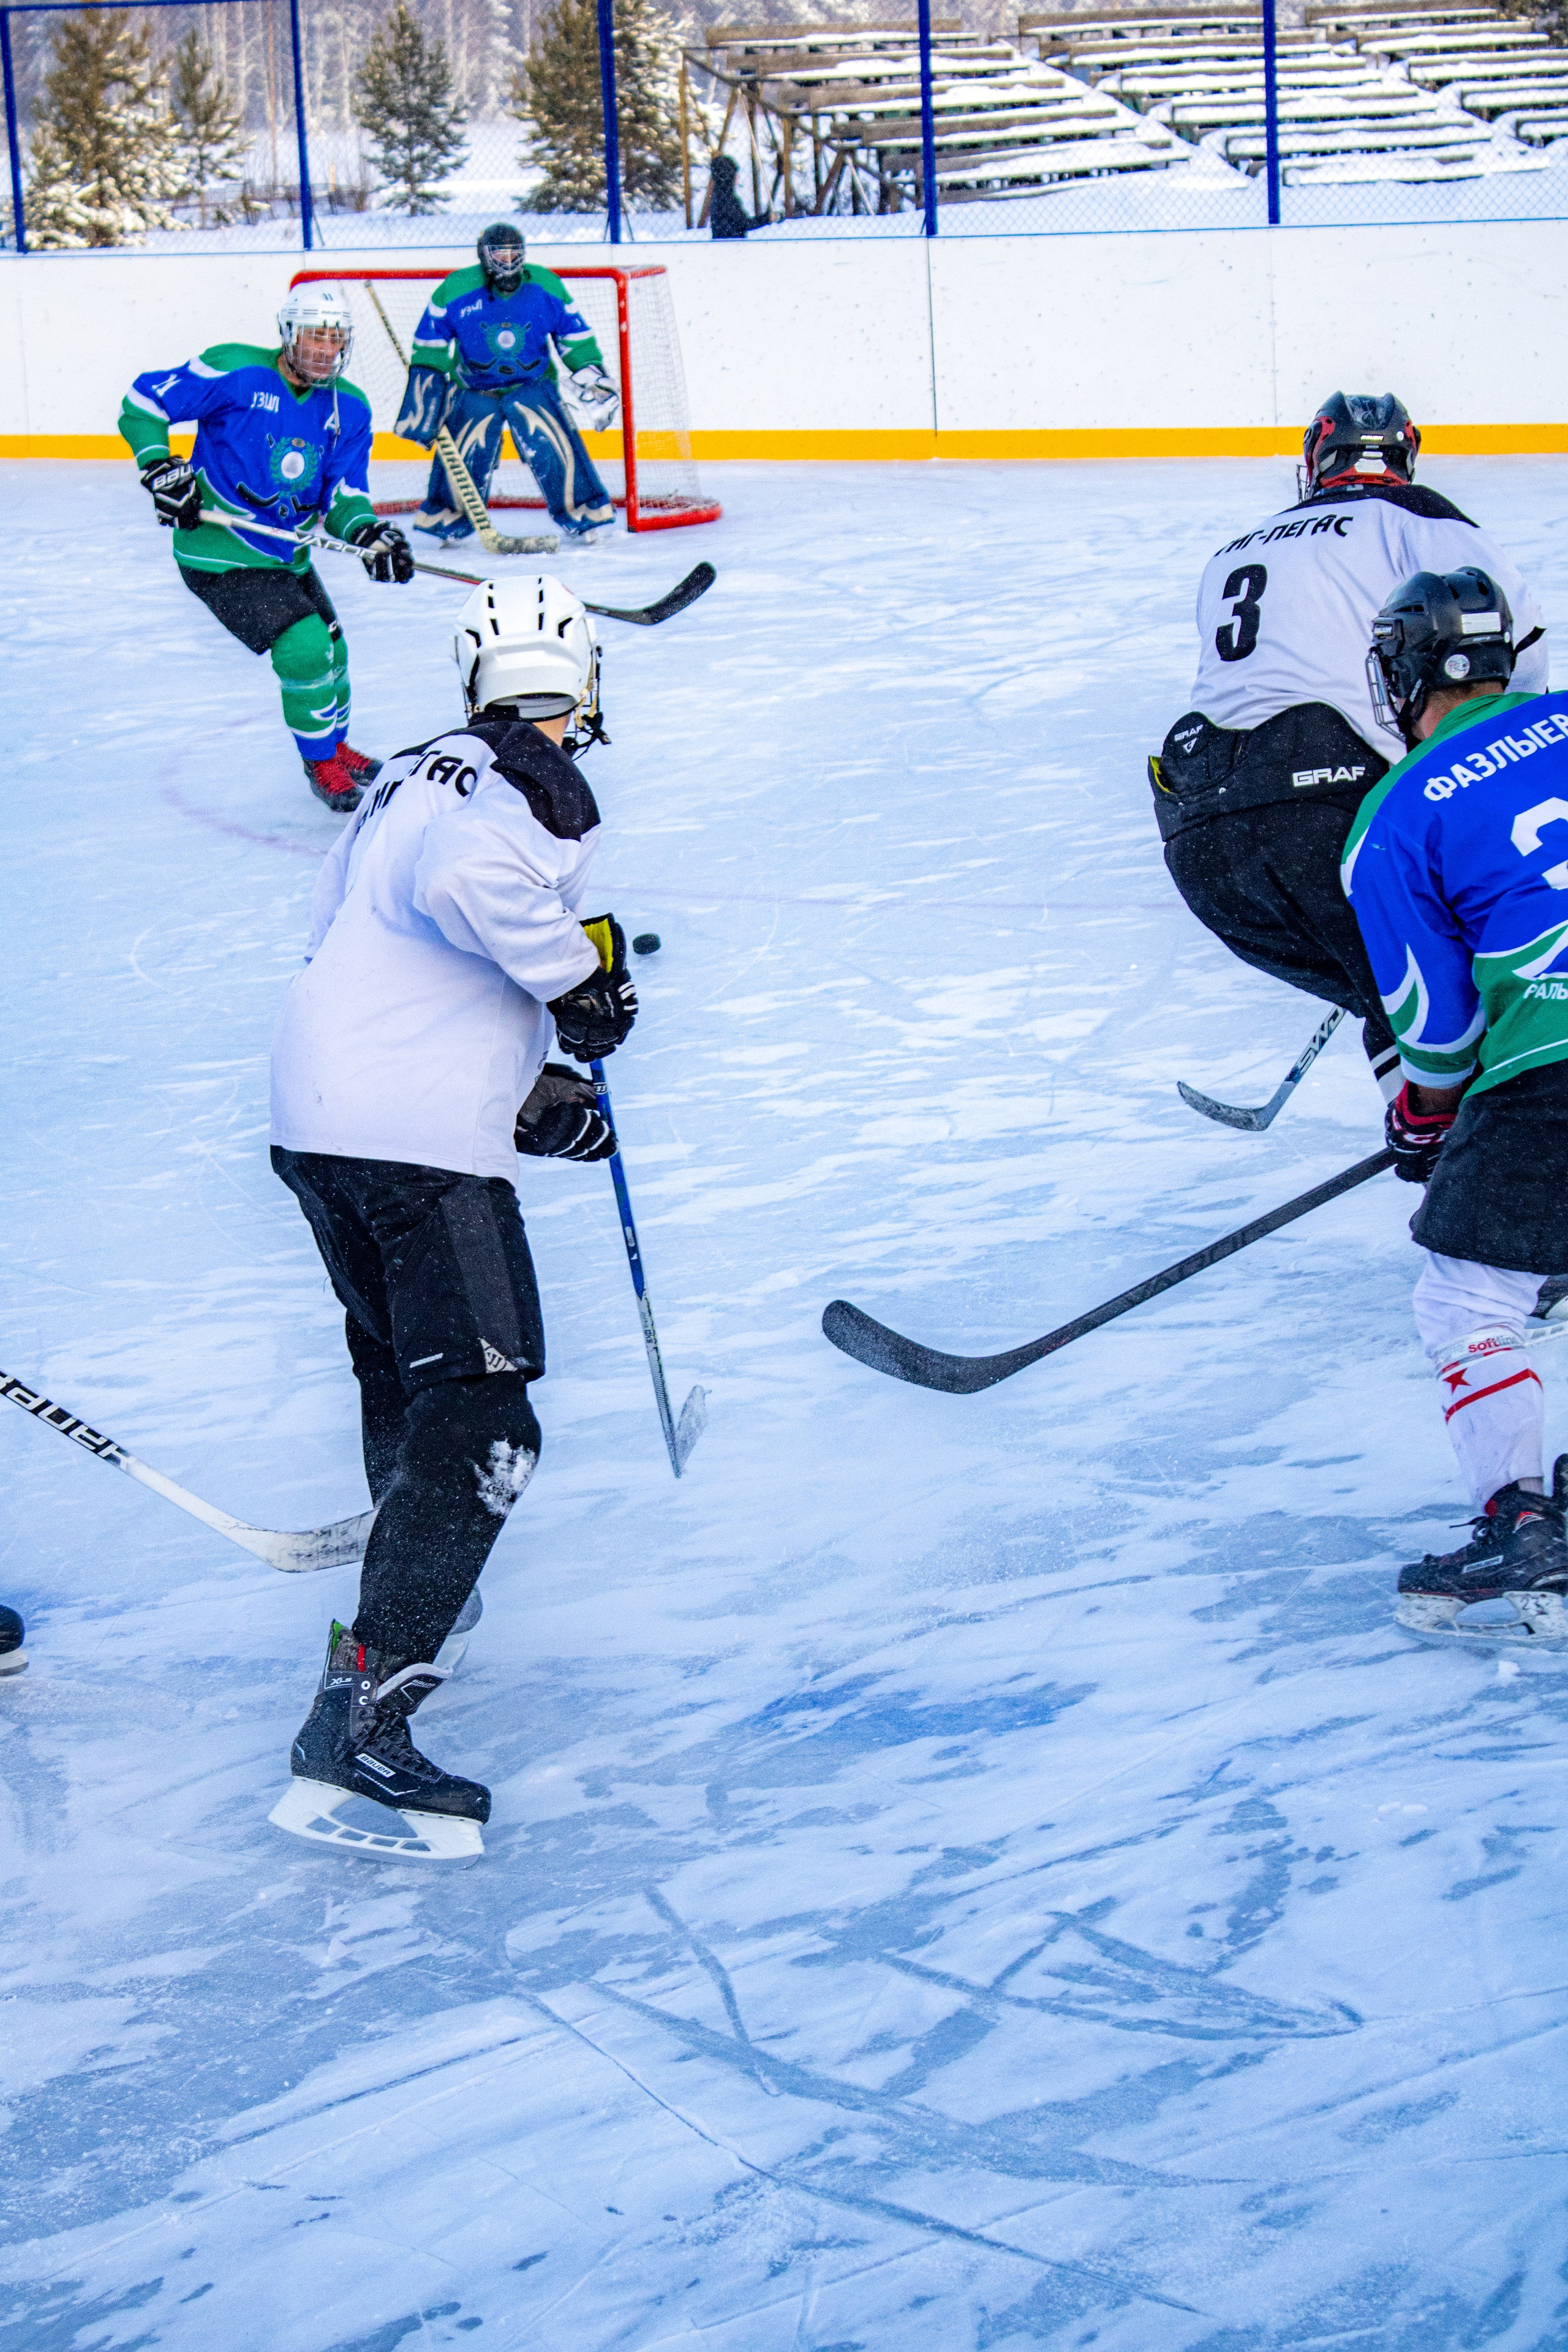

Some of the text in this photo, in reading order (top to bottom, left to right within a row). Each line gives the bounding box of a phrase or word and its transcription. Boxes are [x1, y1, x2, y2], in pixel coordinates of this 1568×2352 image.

[153, 464, 192, 491] BAU
[1214, 513, 1354, 557] ИГ-ПЕГАС
[1215, 564, 1268, 662] 3
[1174, 724, 1204, 742] GRAF
[1293, 766, 1365, 786] GRAF
[360, 1755, 391, 1776] BAUER
